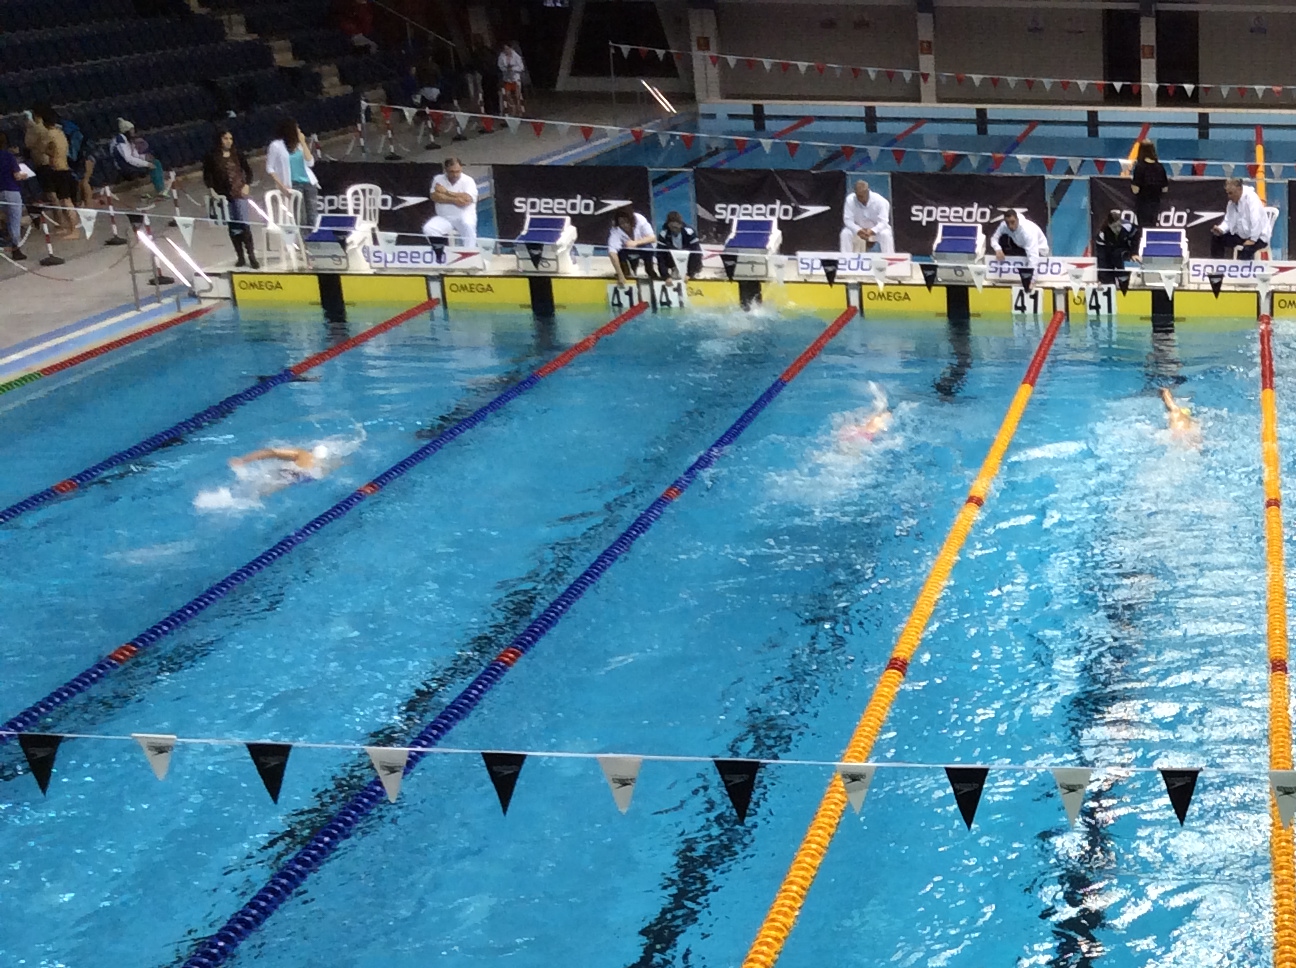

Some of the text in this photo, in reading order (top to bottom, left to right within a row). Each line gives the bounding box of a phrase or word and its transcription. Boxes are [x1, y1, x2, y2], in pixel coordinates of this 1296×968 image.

[514, 194, 594, 215] speedo
[714, 199, 793, 223] speedo
[911, 202, 990, 226] speedo
[800, 253, 872, 275] spedo
[988, 257, 1062, 278] spedo
[238, 279, 284, 291] OMEGA
[449, 282, 495, 294] OMEGA
[867, 290, 912, 302] OMEGA
[611, 285, 634, 308] 41
[660, 286, 685, 309] 41
[1014, 291, 1039, 314] 41
[1088, 287, 1114, 316] 41
